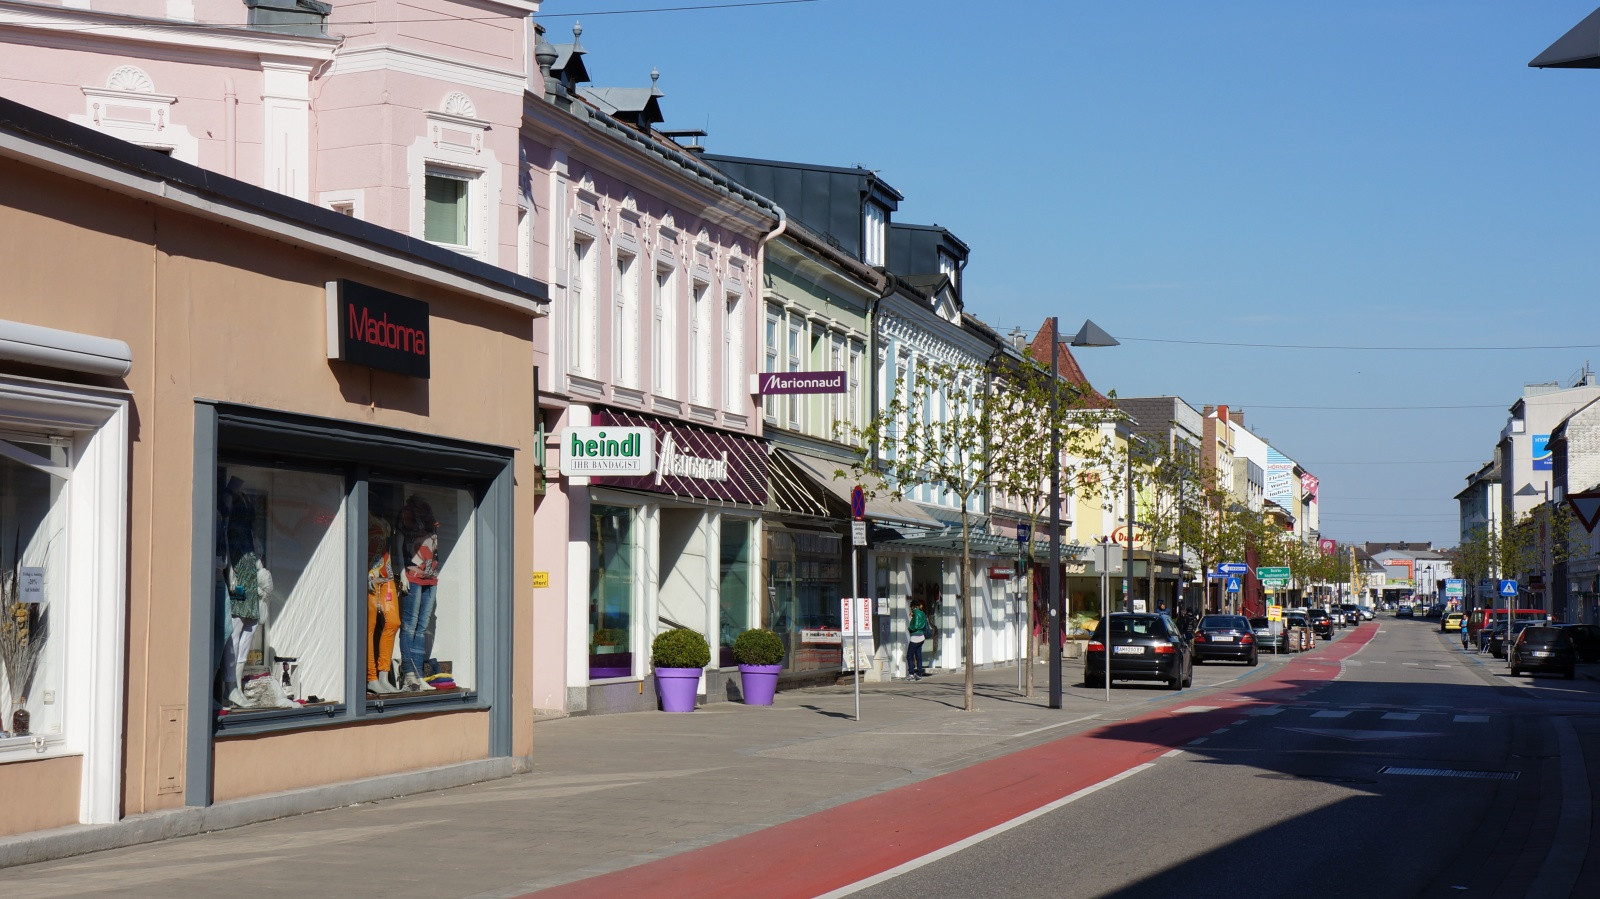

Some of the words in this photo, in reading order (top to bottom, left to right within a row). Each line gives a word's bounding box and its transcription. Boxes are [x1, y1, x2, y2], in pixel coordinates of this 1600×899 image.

[349, 303, 426, 356] Madonna
[763, 374, 841, 392] Marionnaud
[571, 432, 641, 457] heindl
[574, 461, 589, 469] IHR
[592, 461, 638, 470] BANDAGIST
